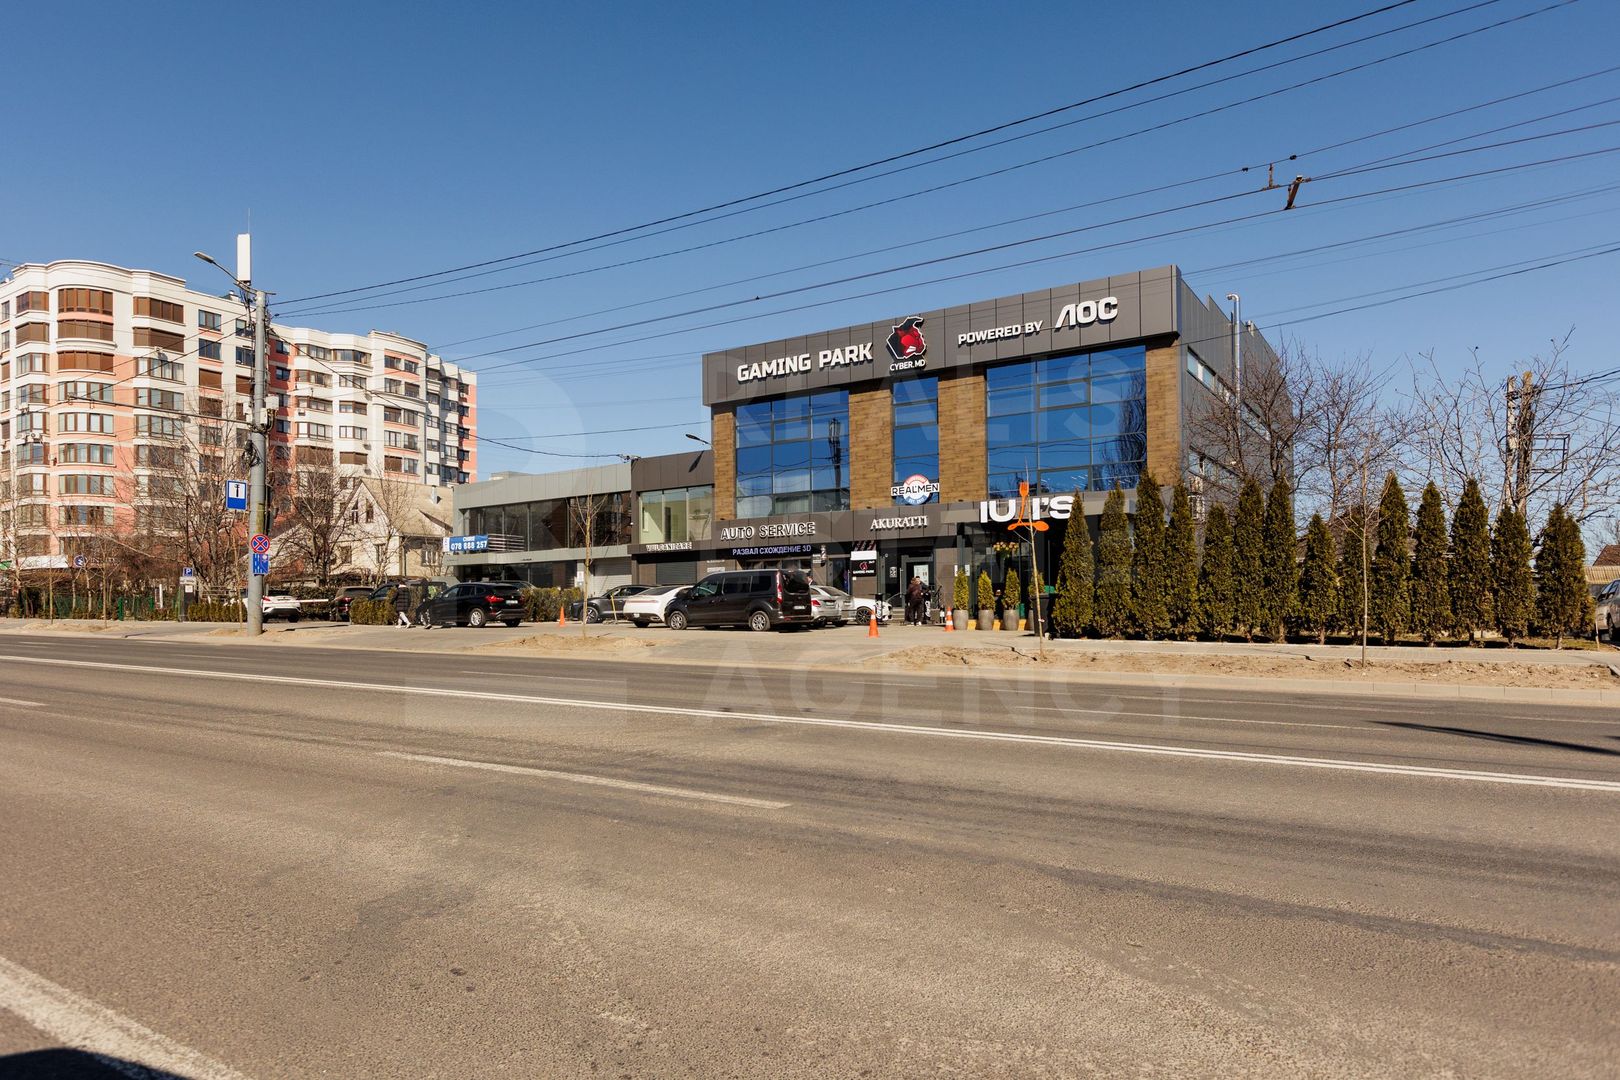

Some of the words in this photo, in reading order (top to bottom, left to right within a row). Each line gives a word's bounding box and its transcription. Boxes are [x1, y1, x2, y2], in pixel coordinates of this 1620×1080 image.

[958, 324, 1021, 345] POWERED
[1025, 320, 1044, 333] BY
[1055, 296, 1118, 329] AOC
[737, 353, 811, 382] GAMING
[819, 342, 873, 368] PARK
[889, 359, 926, 371] CYBER.MD
[720, 525, 755, 541] AUTO
[759, 521, 816, 539] SERVICE
[870, 515, 928, 530] AKURATTI
[802, 544, 812, 552] 3D
